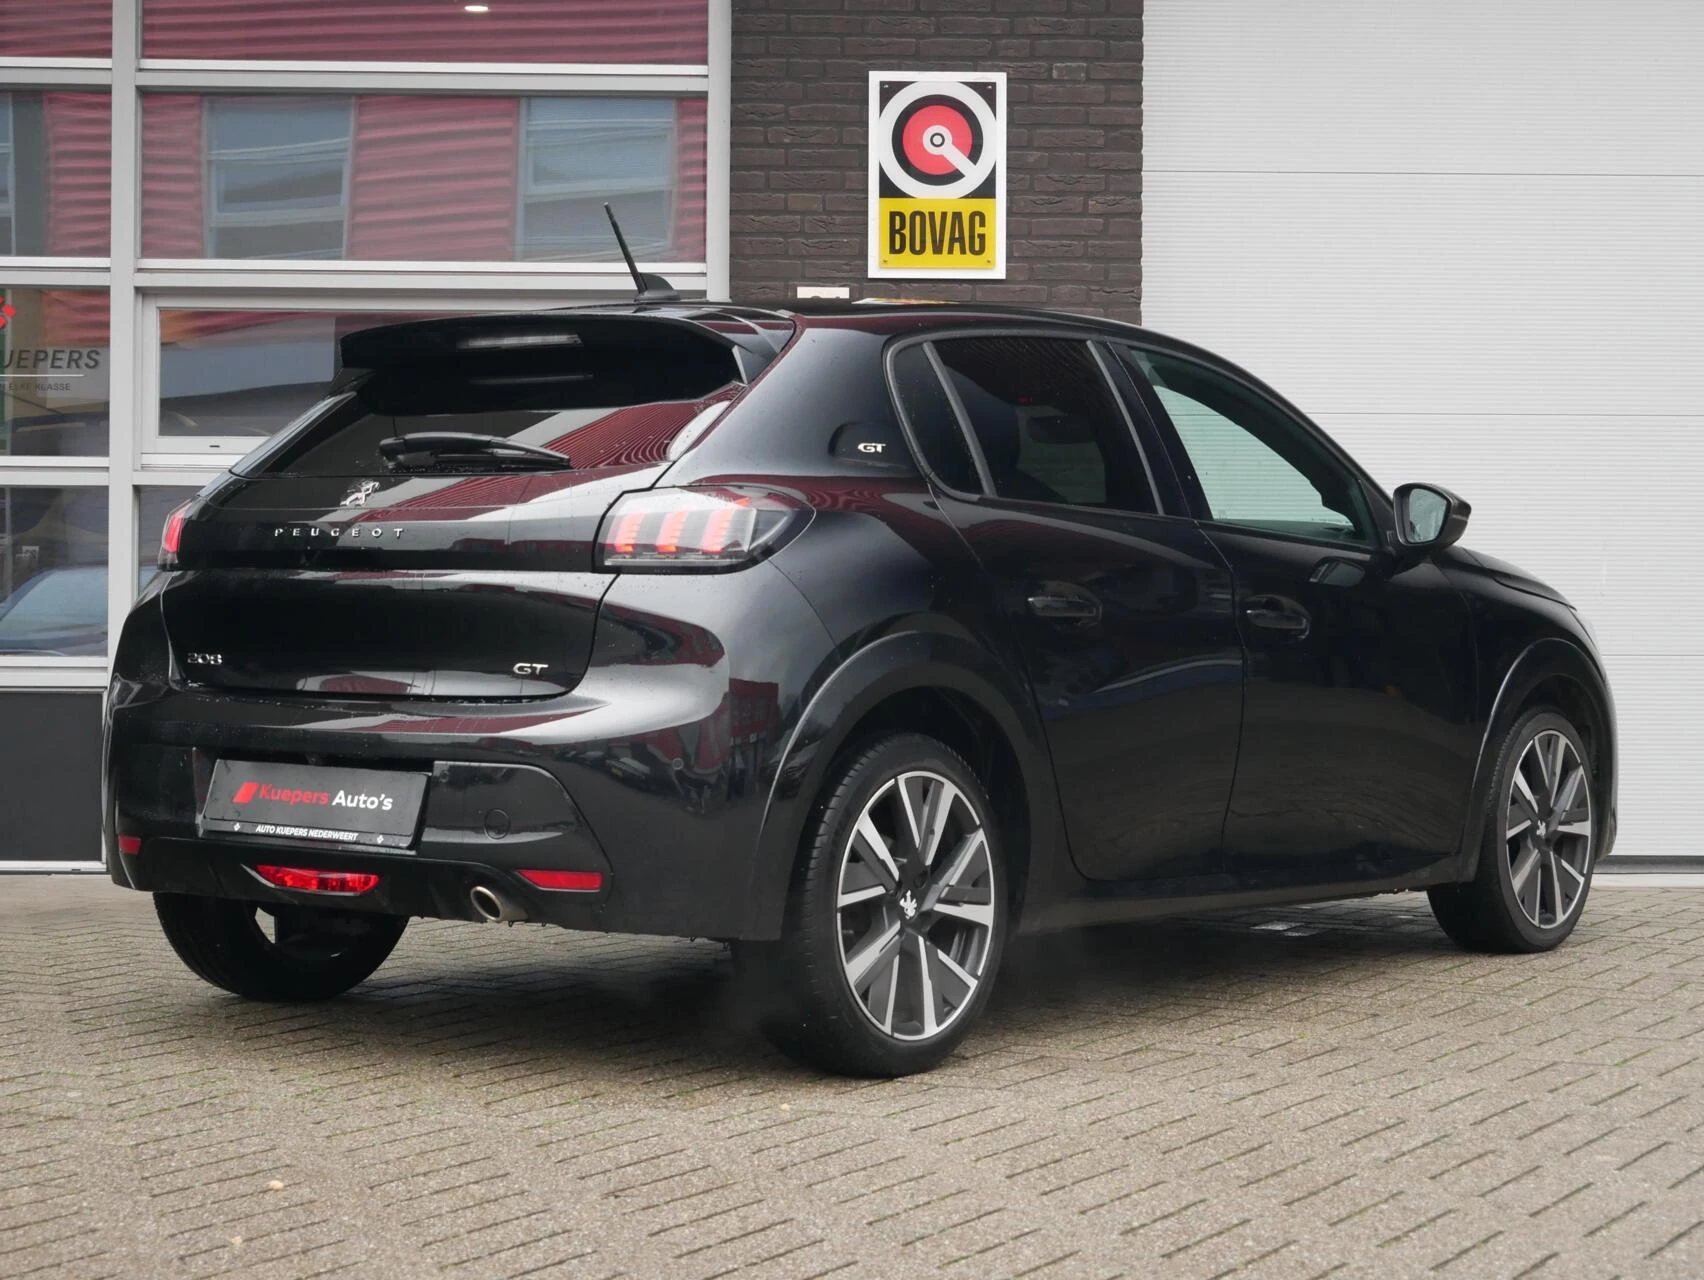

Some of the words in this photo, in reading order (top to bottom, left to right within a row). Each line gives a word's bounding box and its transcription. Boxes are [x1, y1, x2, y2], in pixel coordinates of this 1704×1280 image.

[889, 211, 986, 256] BOVAG
[858, 443, 886, 453] GT
[274, 528, 403, 538] PEUGEOT
[188, 653, 222, 664] 208
[513, 662, 549, 675] GT
[259, 784, 330, 805] Kuepers
[332, 789, 393, 811] Auto's
[256, 825, 275, 833] AUTO
[276, 826, 308, 836] KUEPERS
[308, 829, 359, 841] NEDERWEERT
